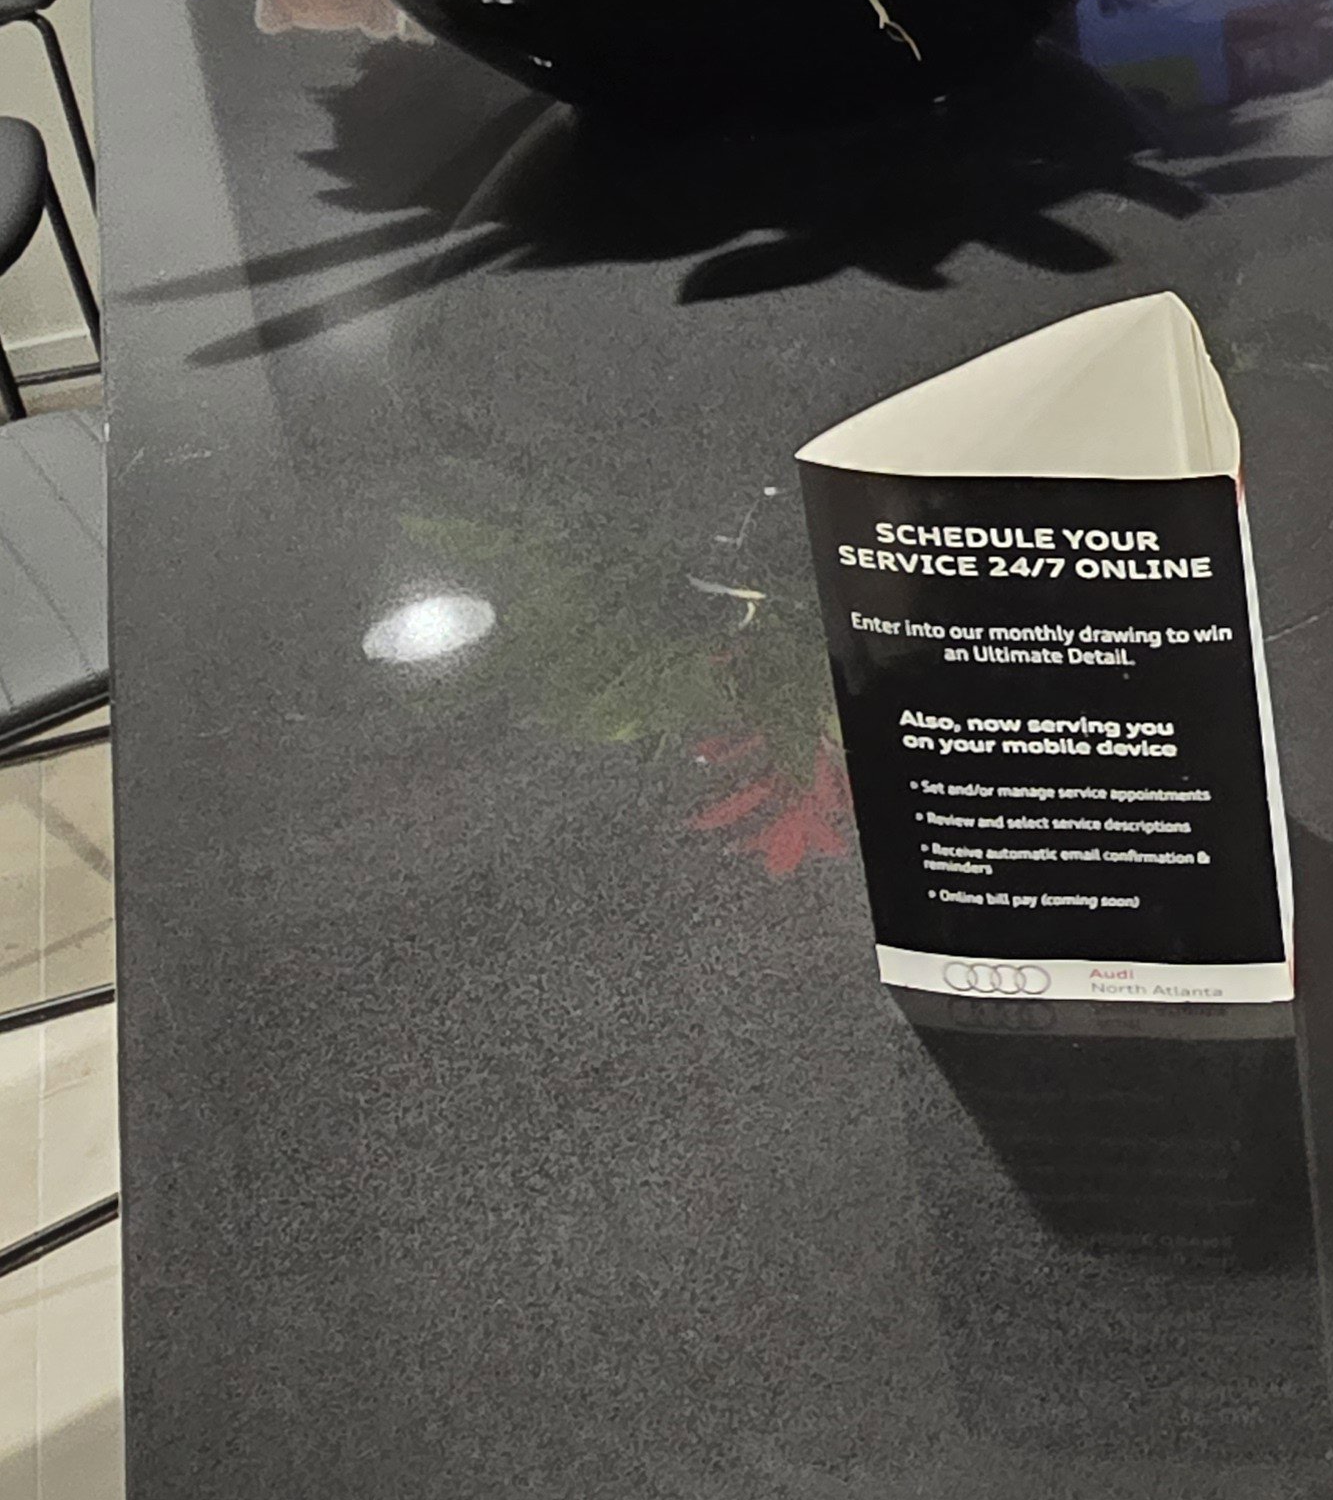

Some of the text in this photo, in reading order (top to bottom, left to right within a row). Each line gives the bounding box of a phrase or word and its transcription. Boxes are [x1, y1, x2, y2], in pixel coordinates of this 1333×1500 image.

[874, 521, 1161, 552] SCHEDULE YOUR
[837, 544, 1213, 581] SERVICE 24/7 ONLINE
[850, 611, 1233, 649] Enter into our monthly drawing to win
[943, 644, 1136, 666] an Ultimate Detail.
[899, 709, 1175, 739] Also, now serving you
[902, 734, 1178, 758] on your mobile device
[920, 779, 1212, 803] Set and/or manage service appointments
[925, 811, 1193, 835] Review and select service descriptions
[931, 841, 984, 860] Receive
[985, 846, 1058, 862] automatic
[1059, 847, 1101, 863] email
[1102, 849, 1195, 865] confirmation
[922, 857, 994, 877] reminders
[938, 887, 1141, 911] Online bill pay (coming soon)
[1089, 968, 1135, 980] Audi
[1091, 982, 1224, 997] North Atlanta
